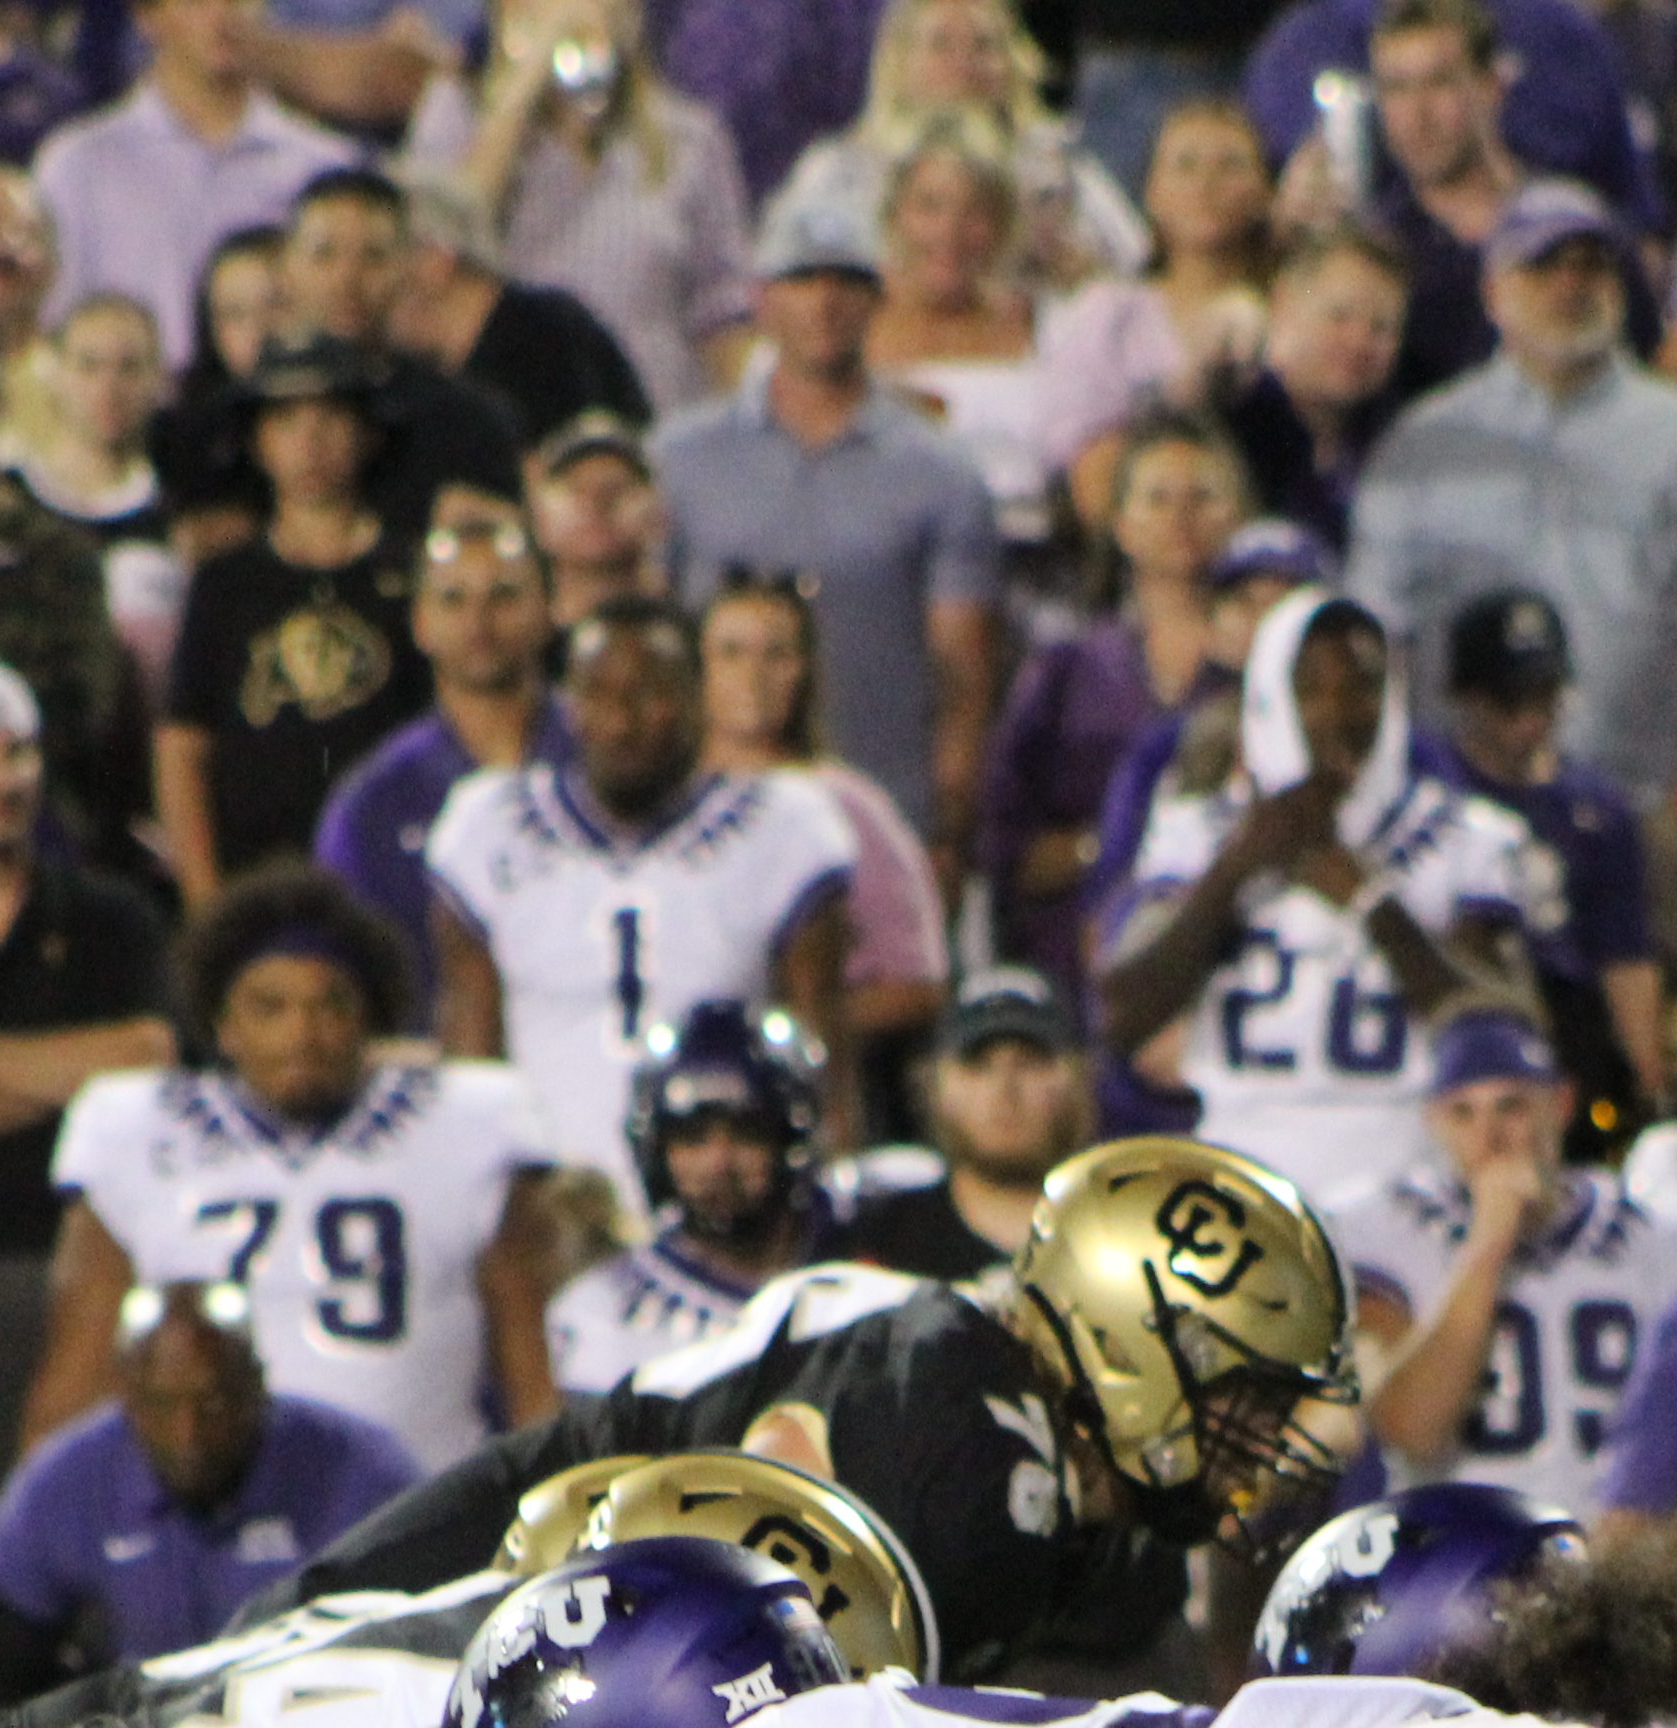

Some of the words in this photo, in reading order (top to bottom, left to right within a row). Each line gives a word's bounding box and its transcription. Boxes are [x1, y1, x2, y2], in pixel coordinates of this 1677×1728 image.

[610, 907, 647, 1040] 1
[1222, 927, 1407, 1074] 26
[195, 1197, 406, 1341] 79
[1156, 1177, 1265, 1299] CU
[711, 1661, 788, 1722] XII
